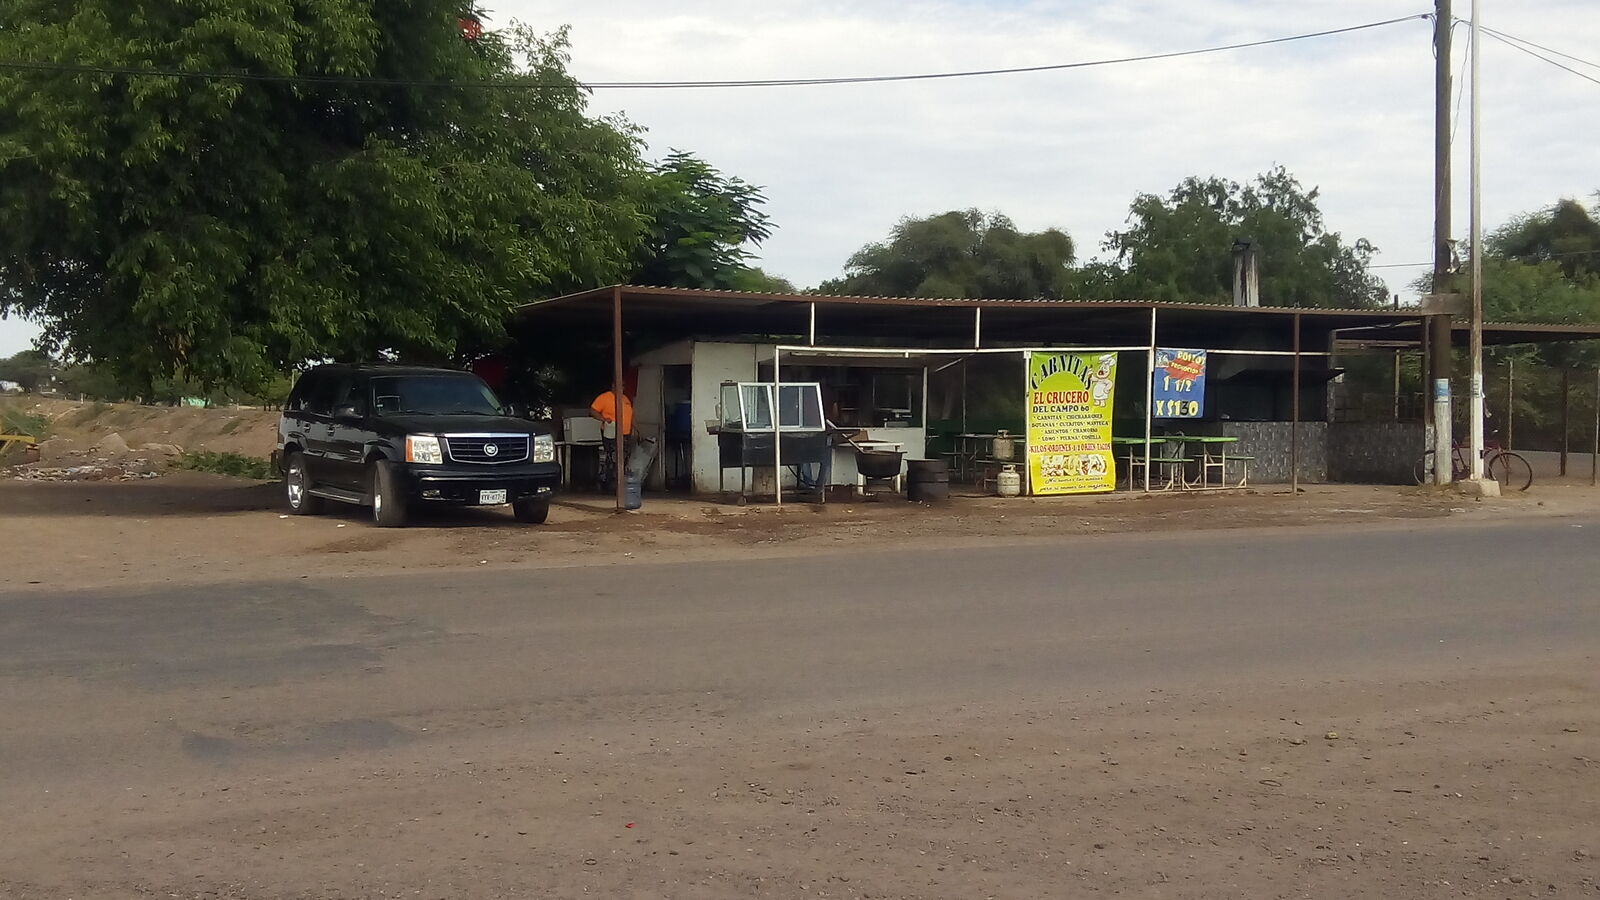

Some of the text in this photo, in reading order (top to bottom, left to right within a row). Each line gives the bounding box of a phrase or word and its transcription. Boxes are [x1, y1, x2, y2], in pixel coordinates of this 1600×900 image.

[1164, 376, 1192, 392] 1 1/2
[1033, 391, 1089, 404] EL CRUCERO
[1050, 405, 1079, 413] CAMPO
[1167, 399, 1199, 416] $130
